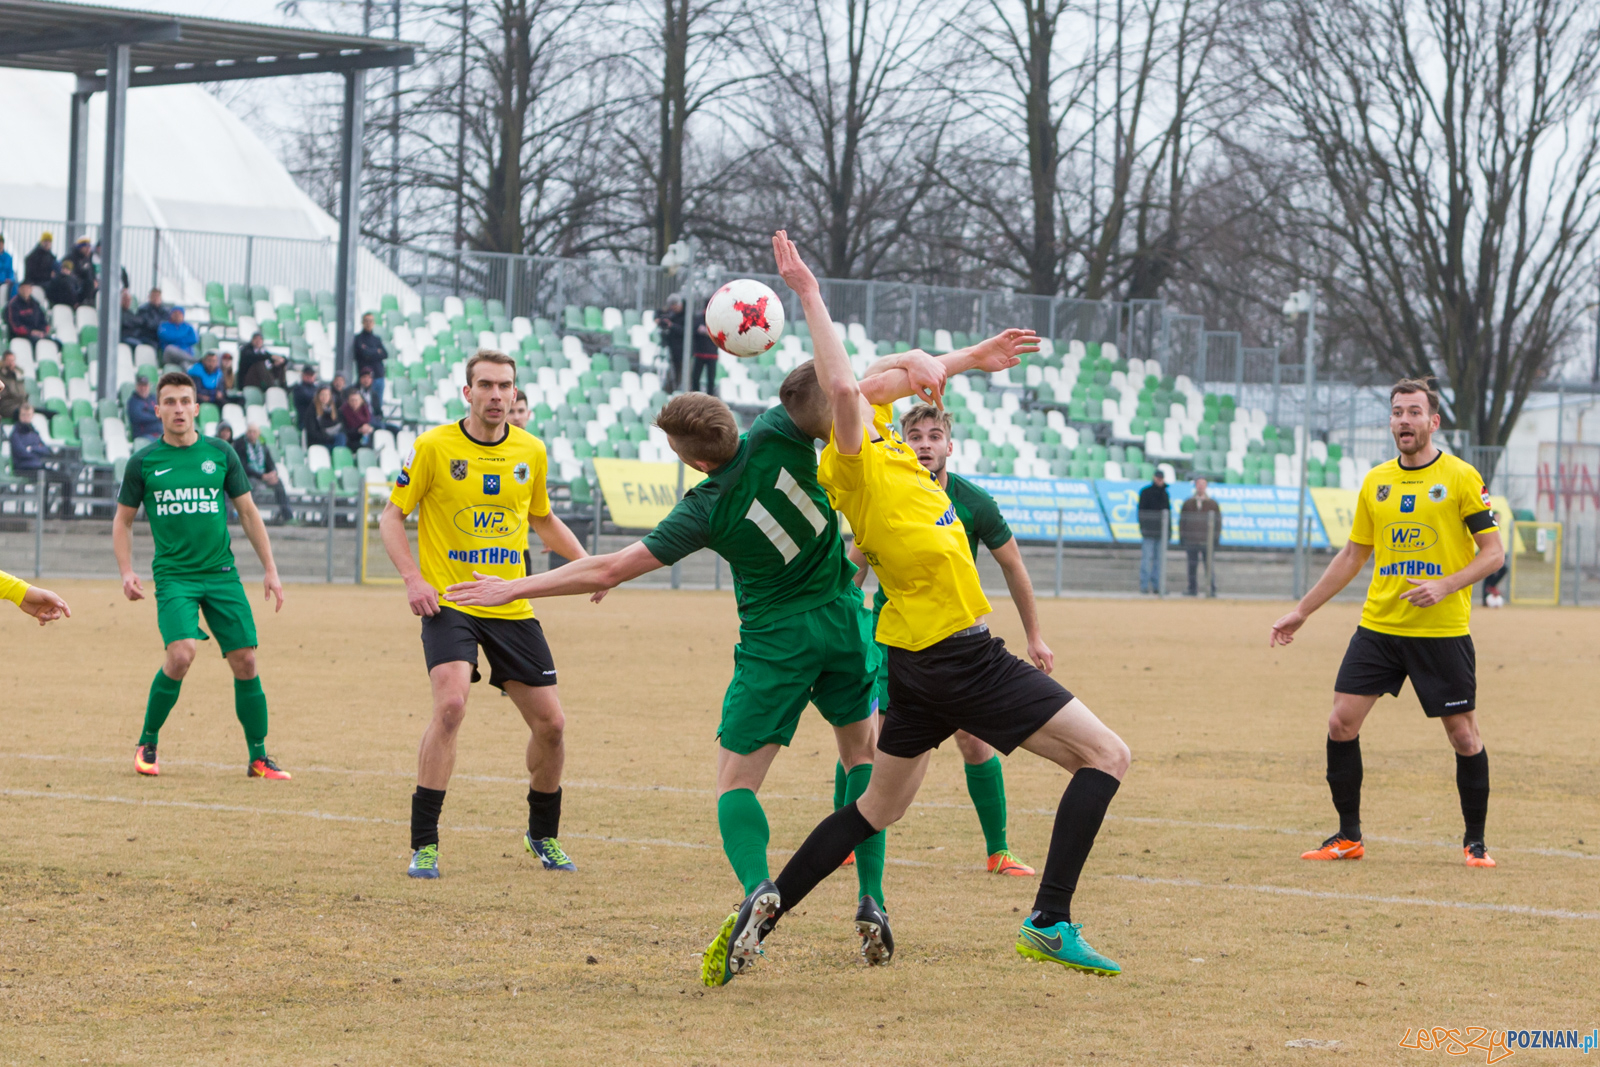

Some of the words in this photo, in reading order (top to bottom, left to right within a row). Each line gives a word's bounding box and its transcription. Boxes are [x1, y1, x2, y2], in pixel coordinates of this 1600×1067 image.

[154, 488, 219, 502] FAMILY
[156, 501, 219, 516] HOUSE
[744, 466, 828, 566] 11
[473, 511, 505, 529] WP
[1391, 528, 1421, 544] WP
[448, 547, 521, 564] NORTHPOL
